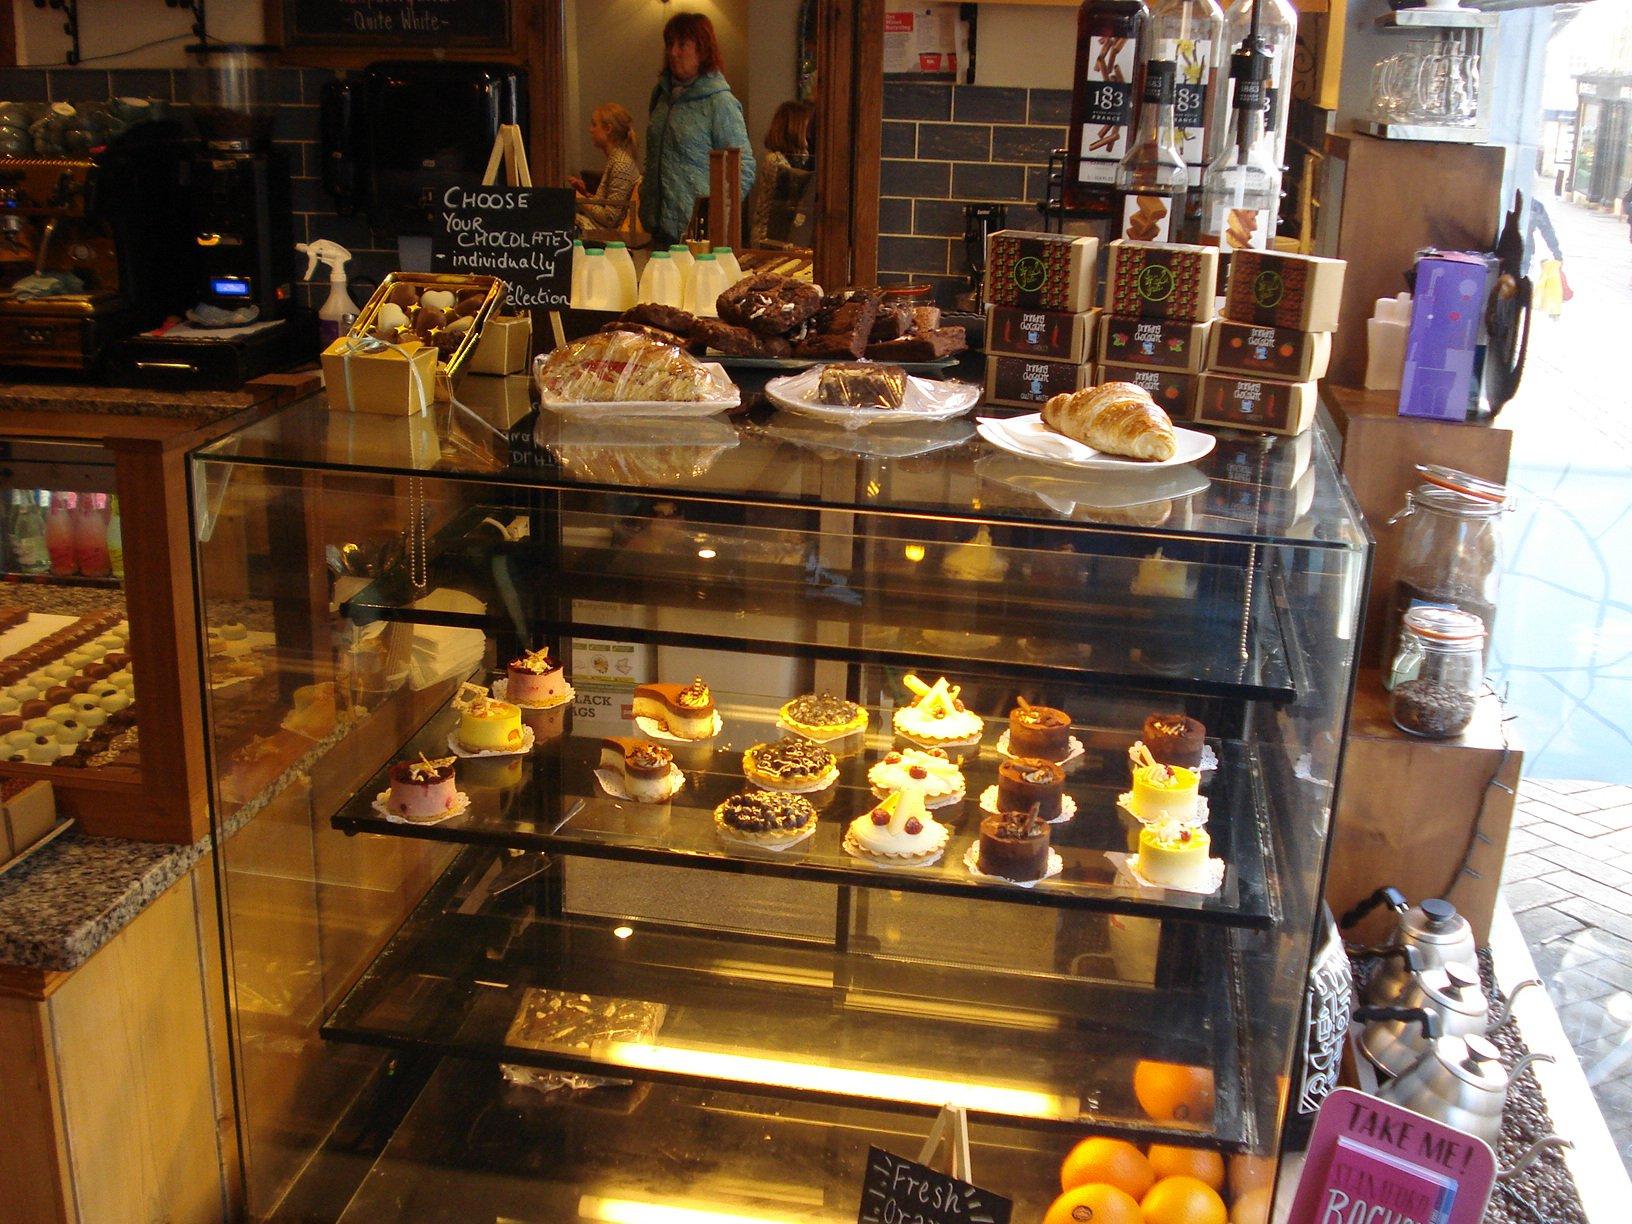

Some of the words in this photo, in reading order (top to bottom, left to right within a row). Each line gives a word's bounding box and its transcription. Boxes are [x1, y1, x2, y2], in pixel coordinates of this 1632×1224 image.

[1090, 114, 1121, 123] FRANCE
[443, 186, 528, 209] CHOOSE
[443, 212, 485, 233] YOUR
[457, 231, 573, 257] CHOCOLATES
[452, 250, 556, 281] individually
[505, 285, 572, 306] election
[574, 694, 612, 706] LACK
[1348, 1101, 1415, 1150] TAKE
[1418, 1131, 1475, 1175] ME!
[893, 1165, 961, 1214] Fresh
